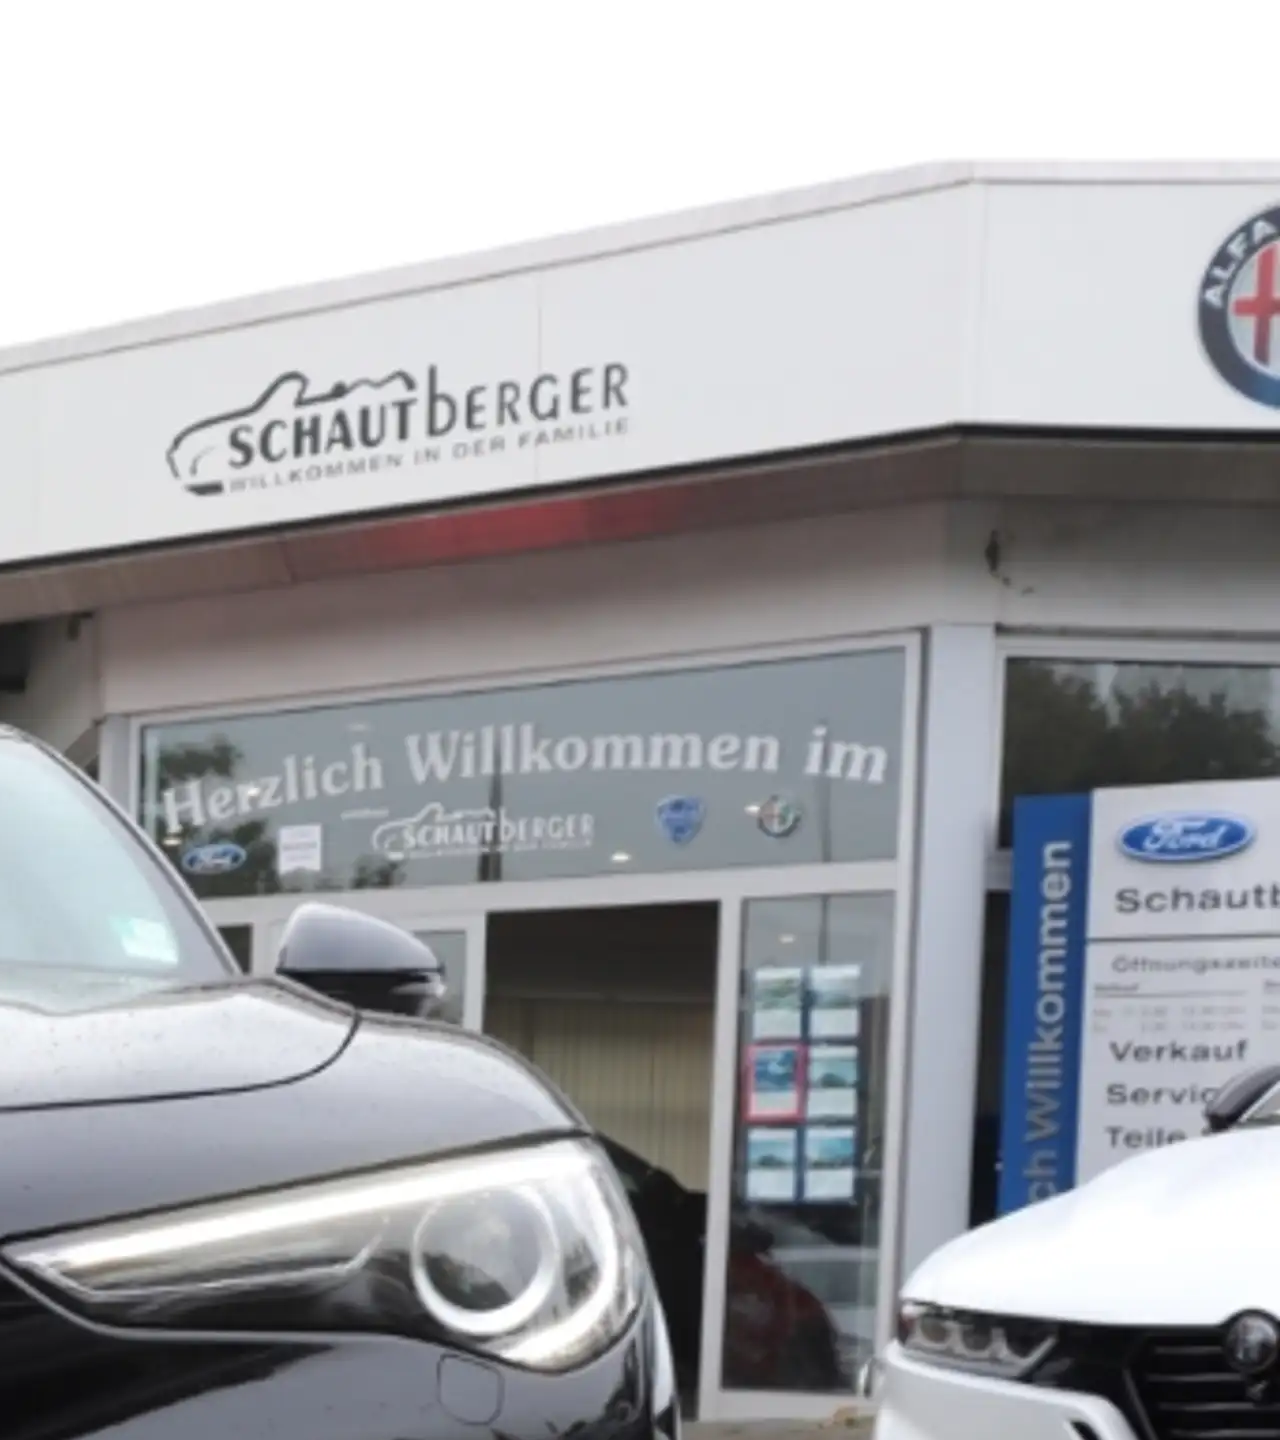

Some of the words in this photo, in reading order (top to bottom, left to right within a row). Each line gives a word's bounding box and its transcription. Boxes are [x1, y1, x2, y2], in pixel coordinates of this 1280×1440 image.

[1204, 219, 1277, 309] ALFA
[229, 454, 403, 493] WILLKOMMEN
[414, 448, 441, 467] IN
[453, 436, 507, 460] DER
[517, 418, 629, 449] FAMILIE
[164, 738, 385, 833] Herzlich
[405, 722, 780, 785] Willkommen
[805, 725, 888, 784] im
[1142, 815, 1226, 851] Ford
[1025, 841, 1074, 1143] Willkommen
[1109, 1039, 1249, 1063] Verkauf
[1106, 1083, 1220, 1107] Servic
